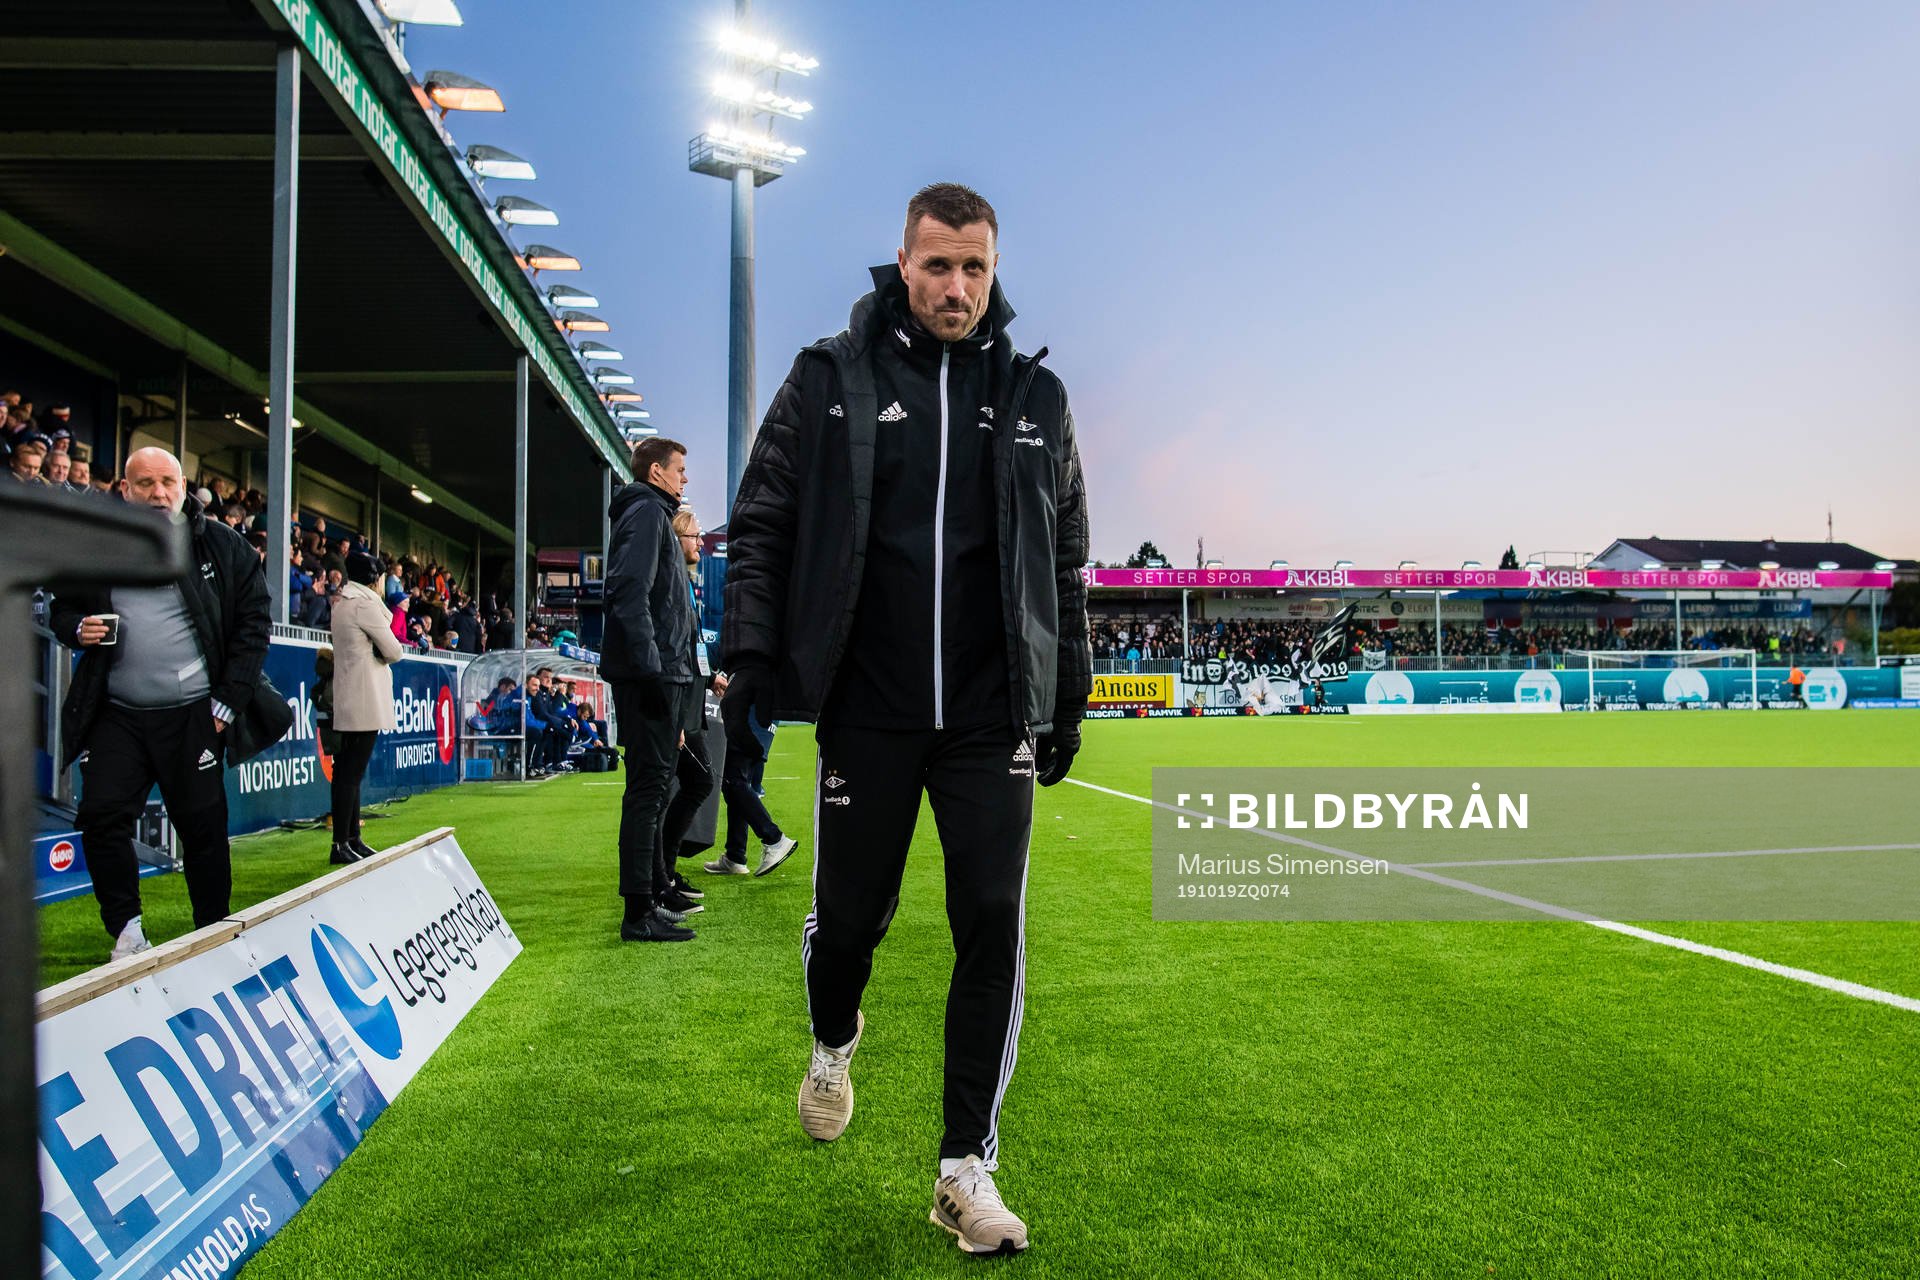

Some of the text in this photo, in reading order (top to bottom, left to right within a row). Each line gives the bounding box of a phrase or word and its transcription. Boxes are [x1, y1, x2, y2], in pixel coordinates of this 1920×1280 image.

[315, 20, 358, 108] notar
[362, 88, 398, 163] notar
[401, 144, 430, 208] notar
[432, 192, 458, 249] notar
[460, 230, 482, 282] notar
[878, 411, 907, 421] adidas
[1134, 572, 1196, 583] SETTER
[1207, 572, 1252, 584] SPOR
[1305, 570, 1355, 586] KBBL
[1384, 572, 1444, 584] SETTER
[1453, 572, 1496, 584] SPOR
[1547, 570, 1595, 587] KBBL
[1622, 573, 1679, 585] SETTER
[1688, 573, 1728, 585] SPOR
[1775, 571, 1821, 588] KBBL
[1407, 604, 1480, 613] ELEKTOSERVICE
[1086, 710, 1124, 718] macron
[1203, 707, 1237, 715] RAMVIK
[396, 743, 436, 769] NORDVEST
[239, 756, 315, 794] NORDVEST
[369, 886, 507, 1007] Legeregnskap
[104, 954, 339, 1197] DRIFT
[240, 1193, 272, 1239] AS
